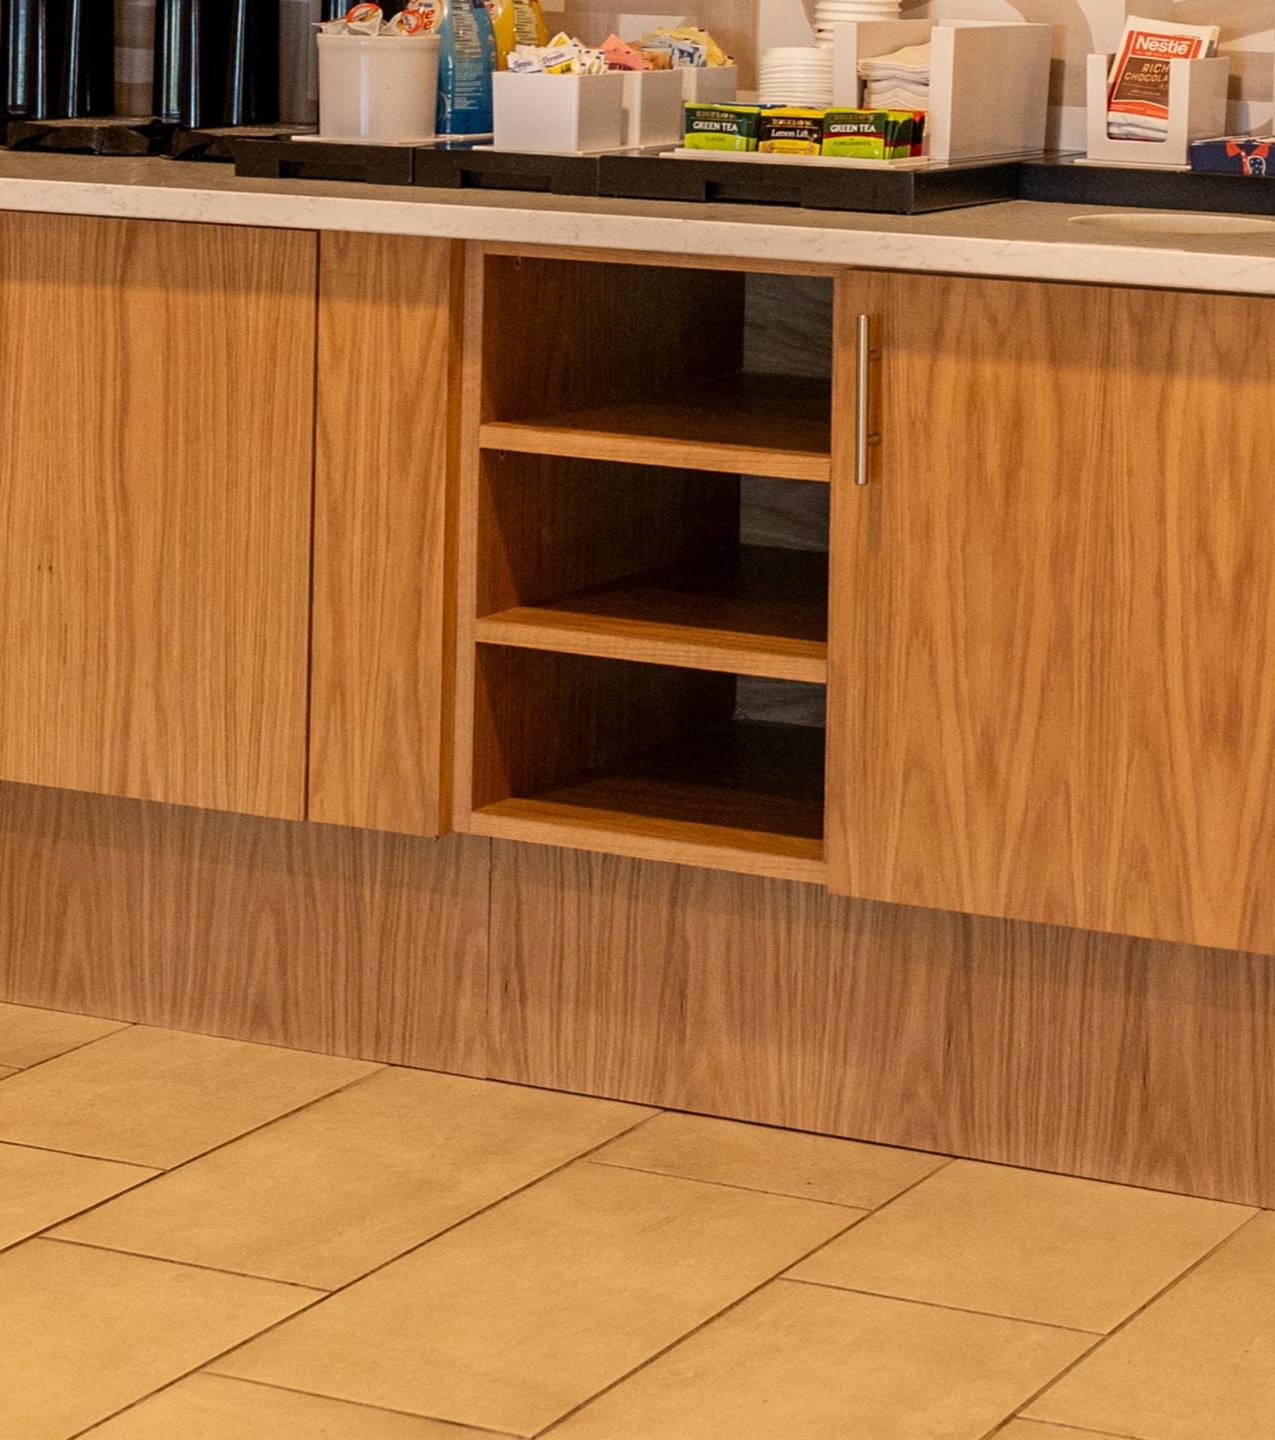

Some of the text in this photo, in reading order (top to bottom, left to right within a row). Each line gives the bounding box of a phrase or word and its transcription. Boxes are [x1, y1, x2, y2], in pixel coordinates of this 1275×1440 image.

[1142, 63, 1171, 73] RICH
[1124, 72, 1169, 83] CHOCOLA
[692, 121, 739, 132] GREEN TEA
[830, 123, 876, 133] GREEN TEA
[771, 128, 796, 138] Lemon
